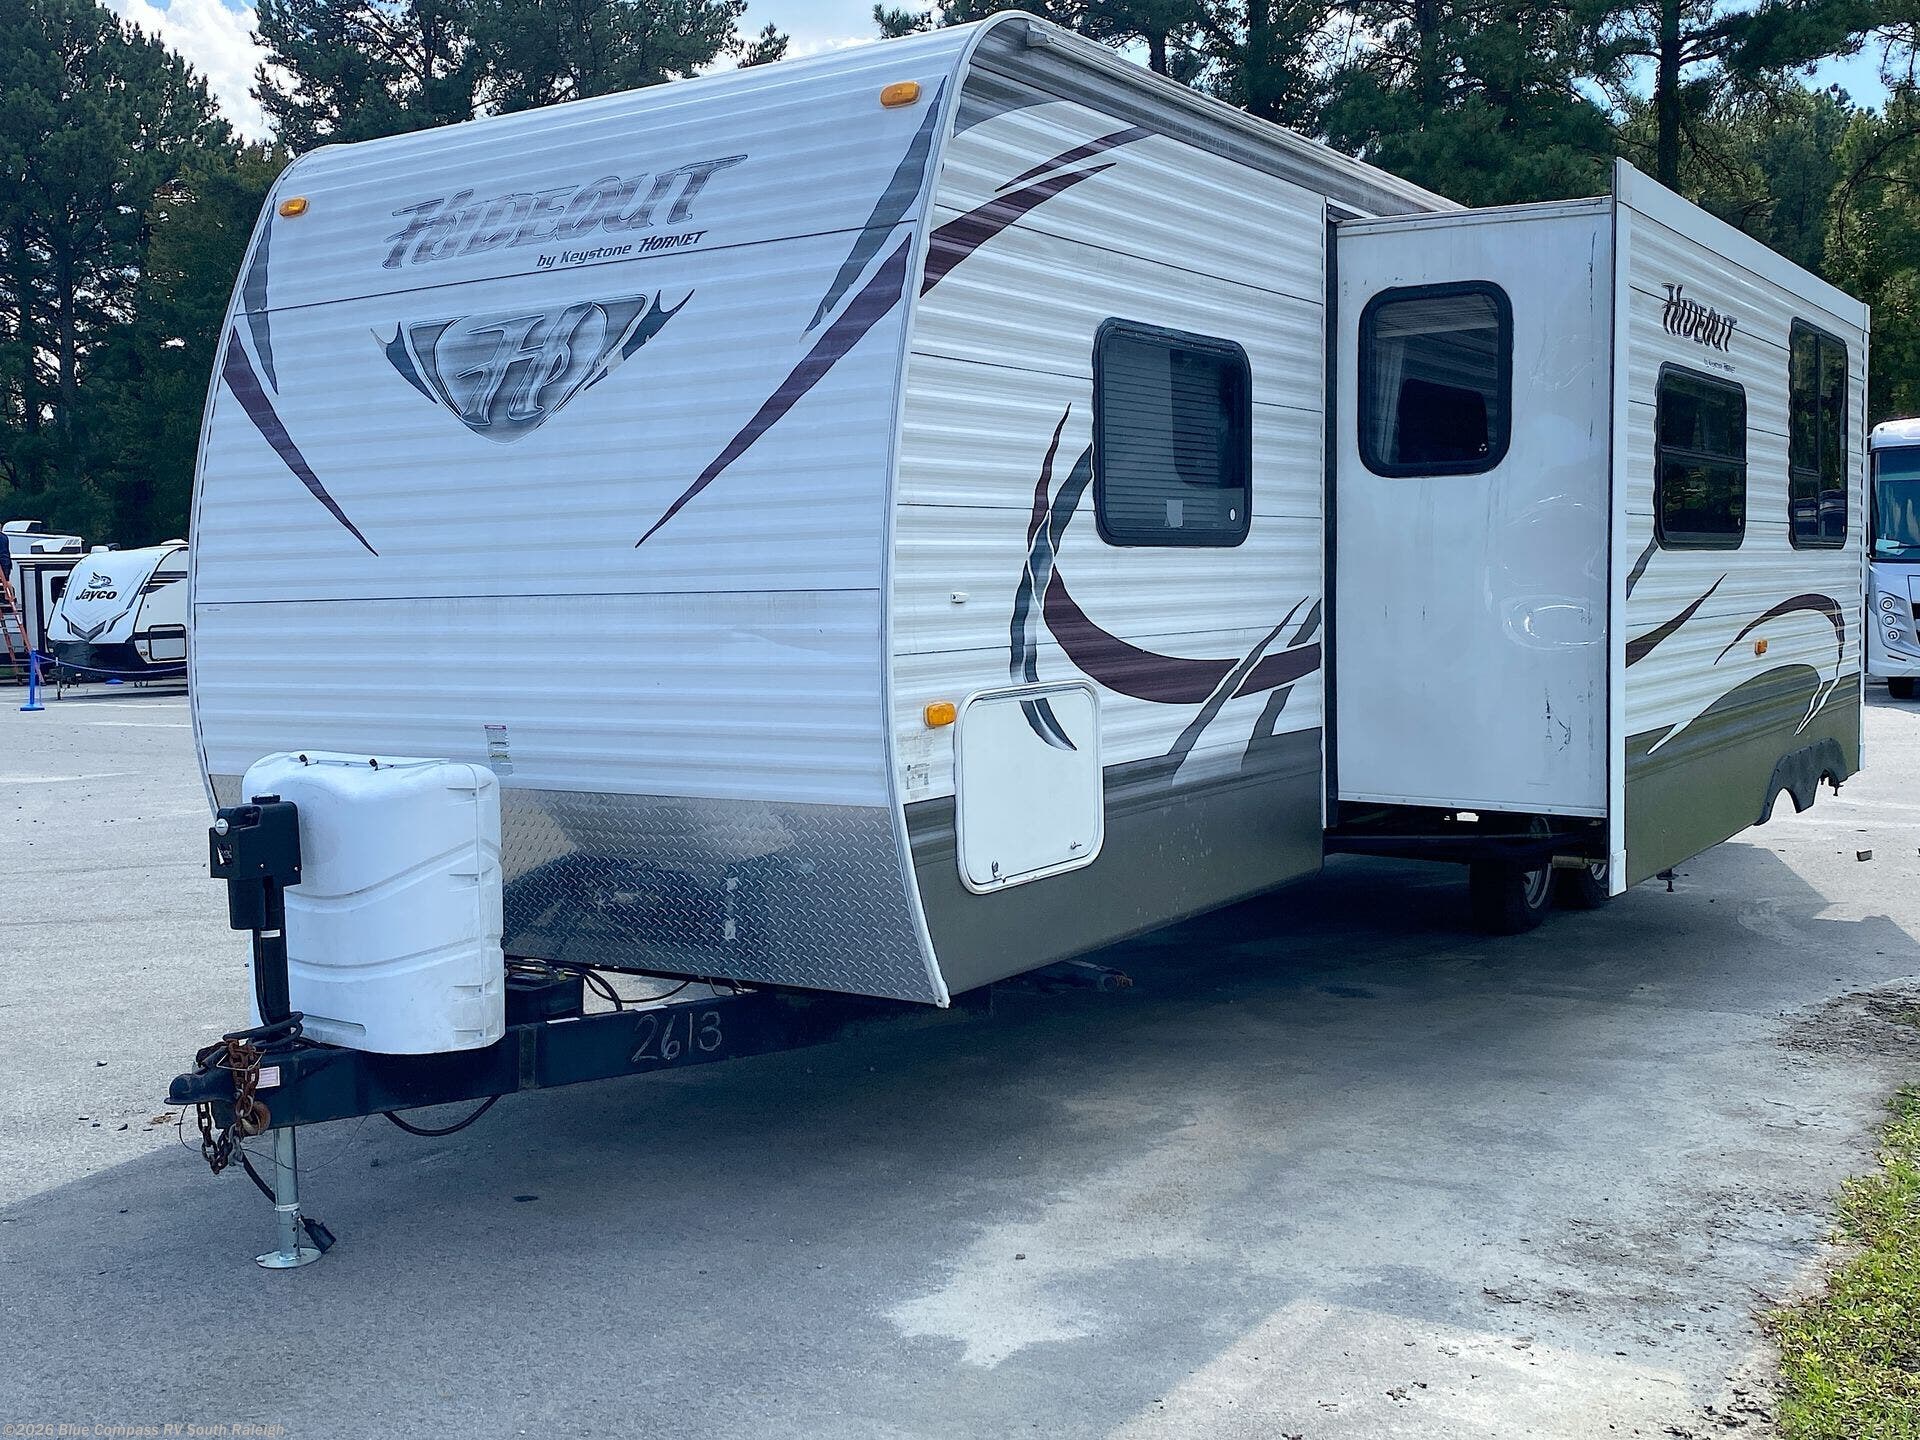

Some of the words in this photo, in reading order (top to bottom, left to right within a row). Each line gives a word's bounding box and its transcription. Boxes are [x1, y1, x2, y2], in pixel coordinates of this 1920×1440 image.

[536, 254, 557, 270] by
[559, 244, 632, 265] Keystone
[638, 230, 708, 253] HORNET
[75, 588, 118, 602] Jayco
[630, 1011, 723, 1064] 2613
